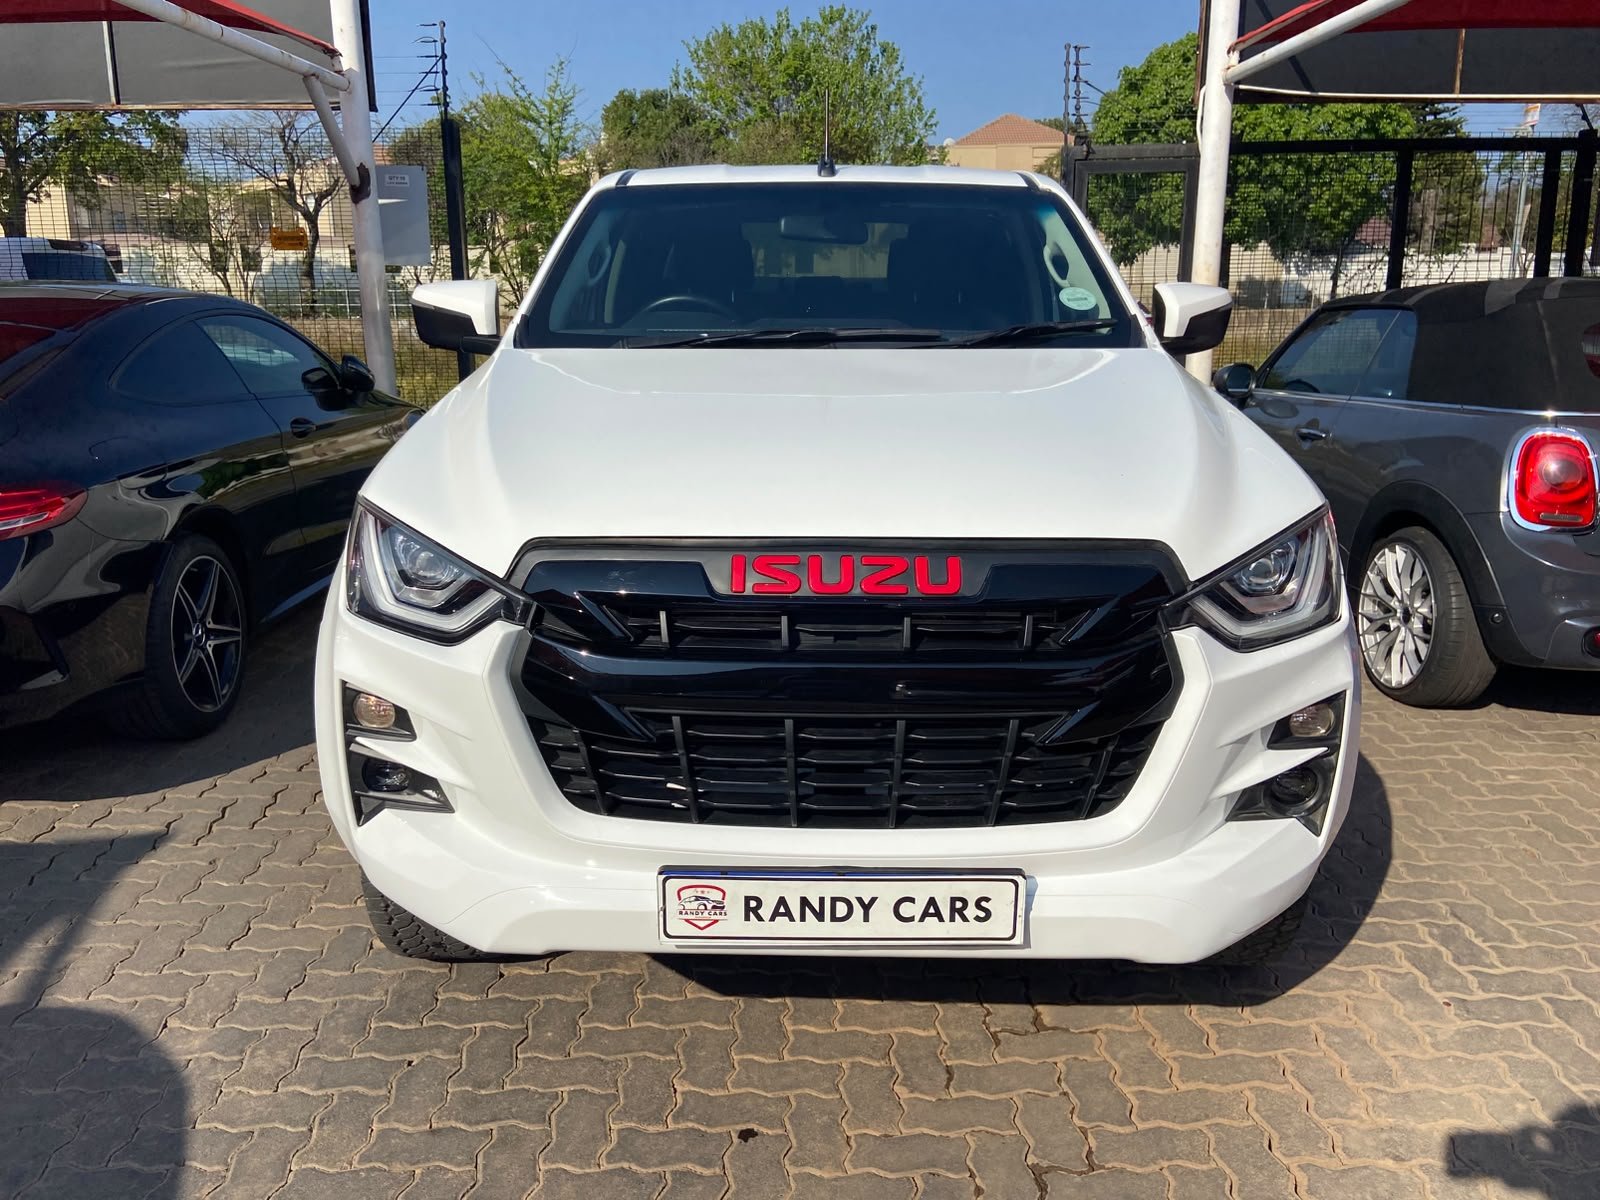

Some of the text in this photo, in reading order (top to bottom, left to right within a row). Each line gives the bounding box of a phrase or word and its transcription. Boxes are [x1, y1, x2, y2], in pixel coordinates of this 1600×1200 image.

[731, 554, 962, 595] ISUZU
[743, 896, 993, 923] RANDY CARS
